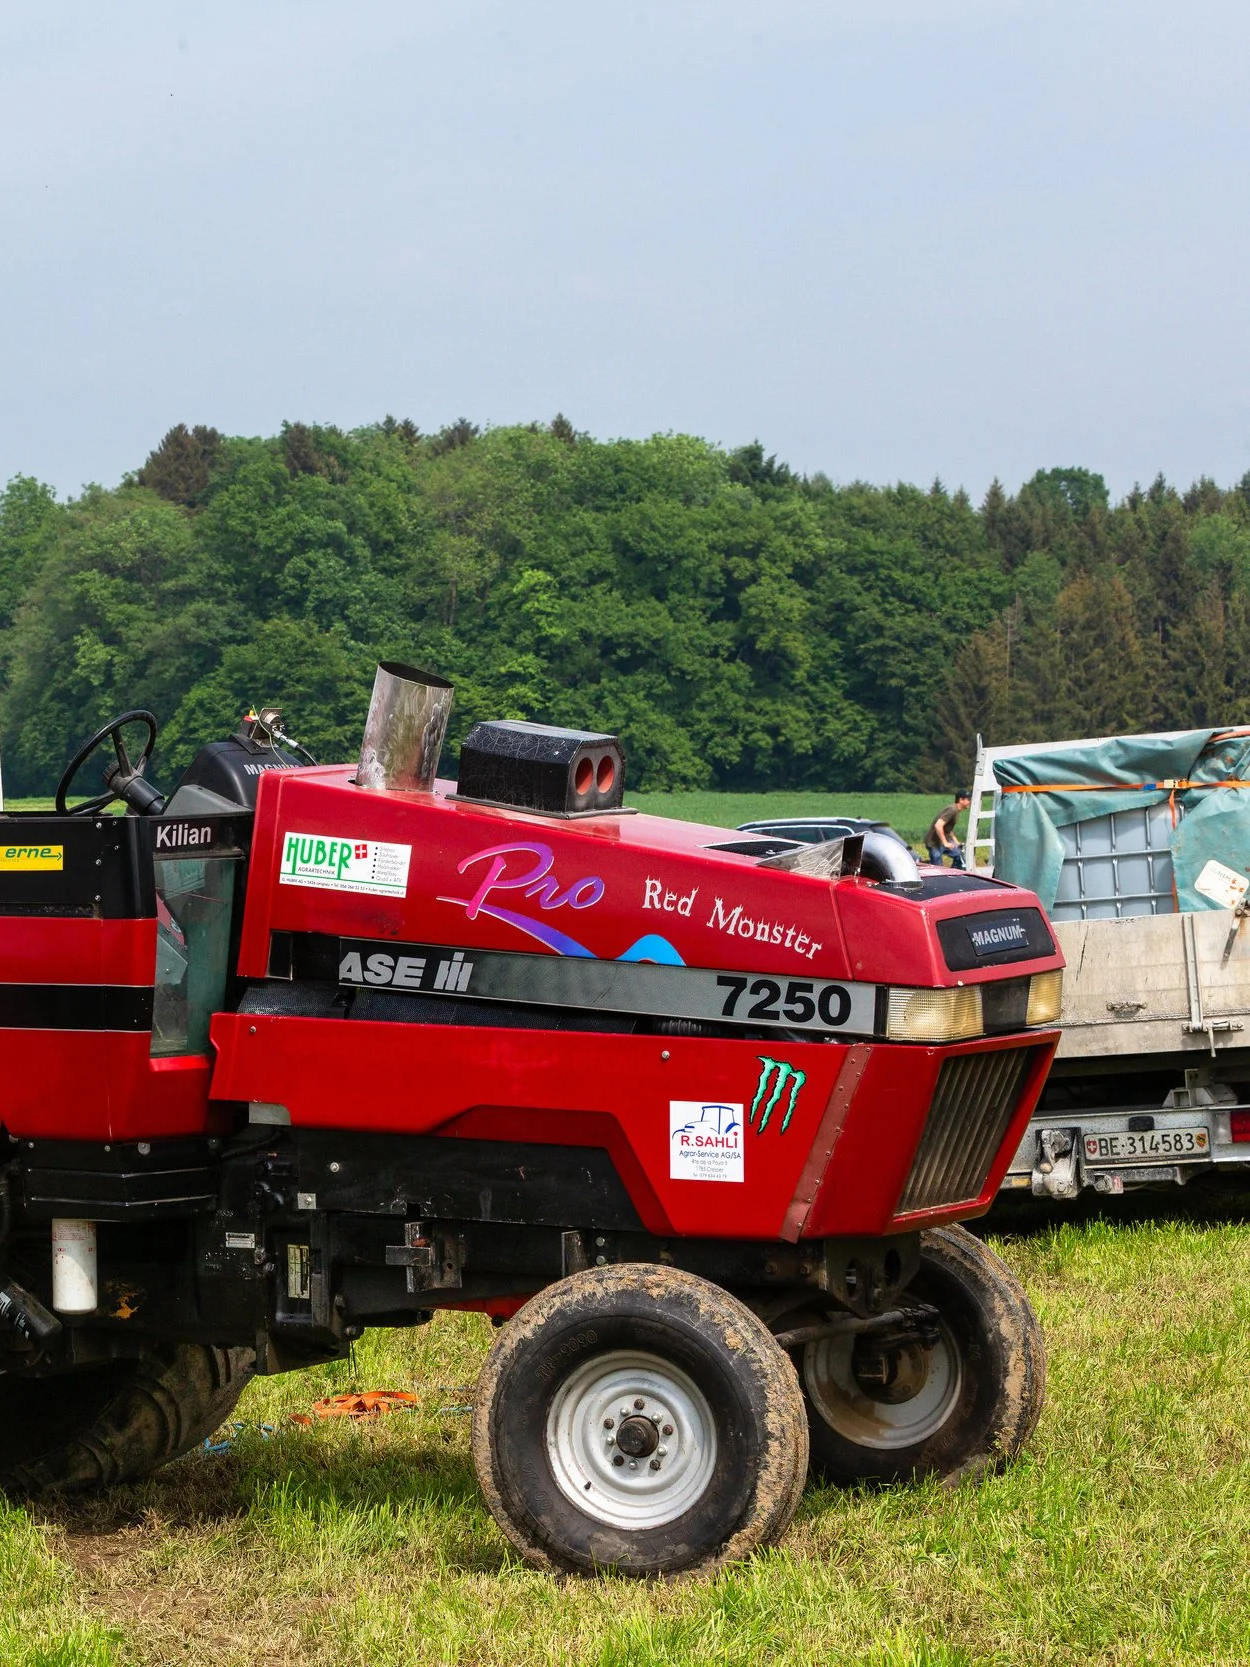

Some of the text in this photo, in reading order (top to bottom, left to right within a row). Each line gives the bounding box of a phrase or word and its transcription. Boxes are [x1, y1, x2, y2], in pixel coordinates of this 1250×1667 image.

[156, 824, 212, 848] Kilian
[5, 847, 53, 859] erne
[286, 837, 352, 880] HUBER
[298, 866, 336, 876] AGRARTECHNIK
[456, 841, 606, 921] Pro
[642, 876, 823, 961] Red Monster
[974, 924, 1023, 946] MAGNUM
[716, 975, 852, 1028] 7250
[679, 1150, 741, 1159] Agrar-Service AG/SA
